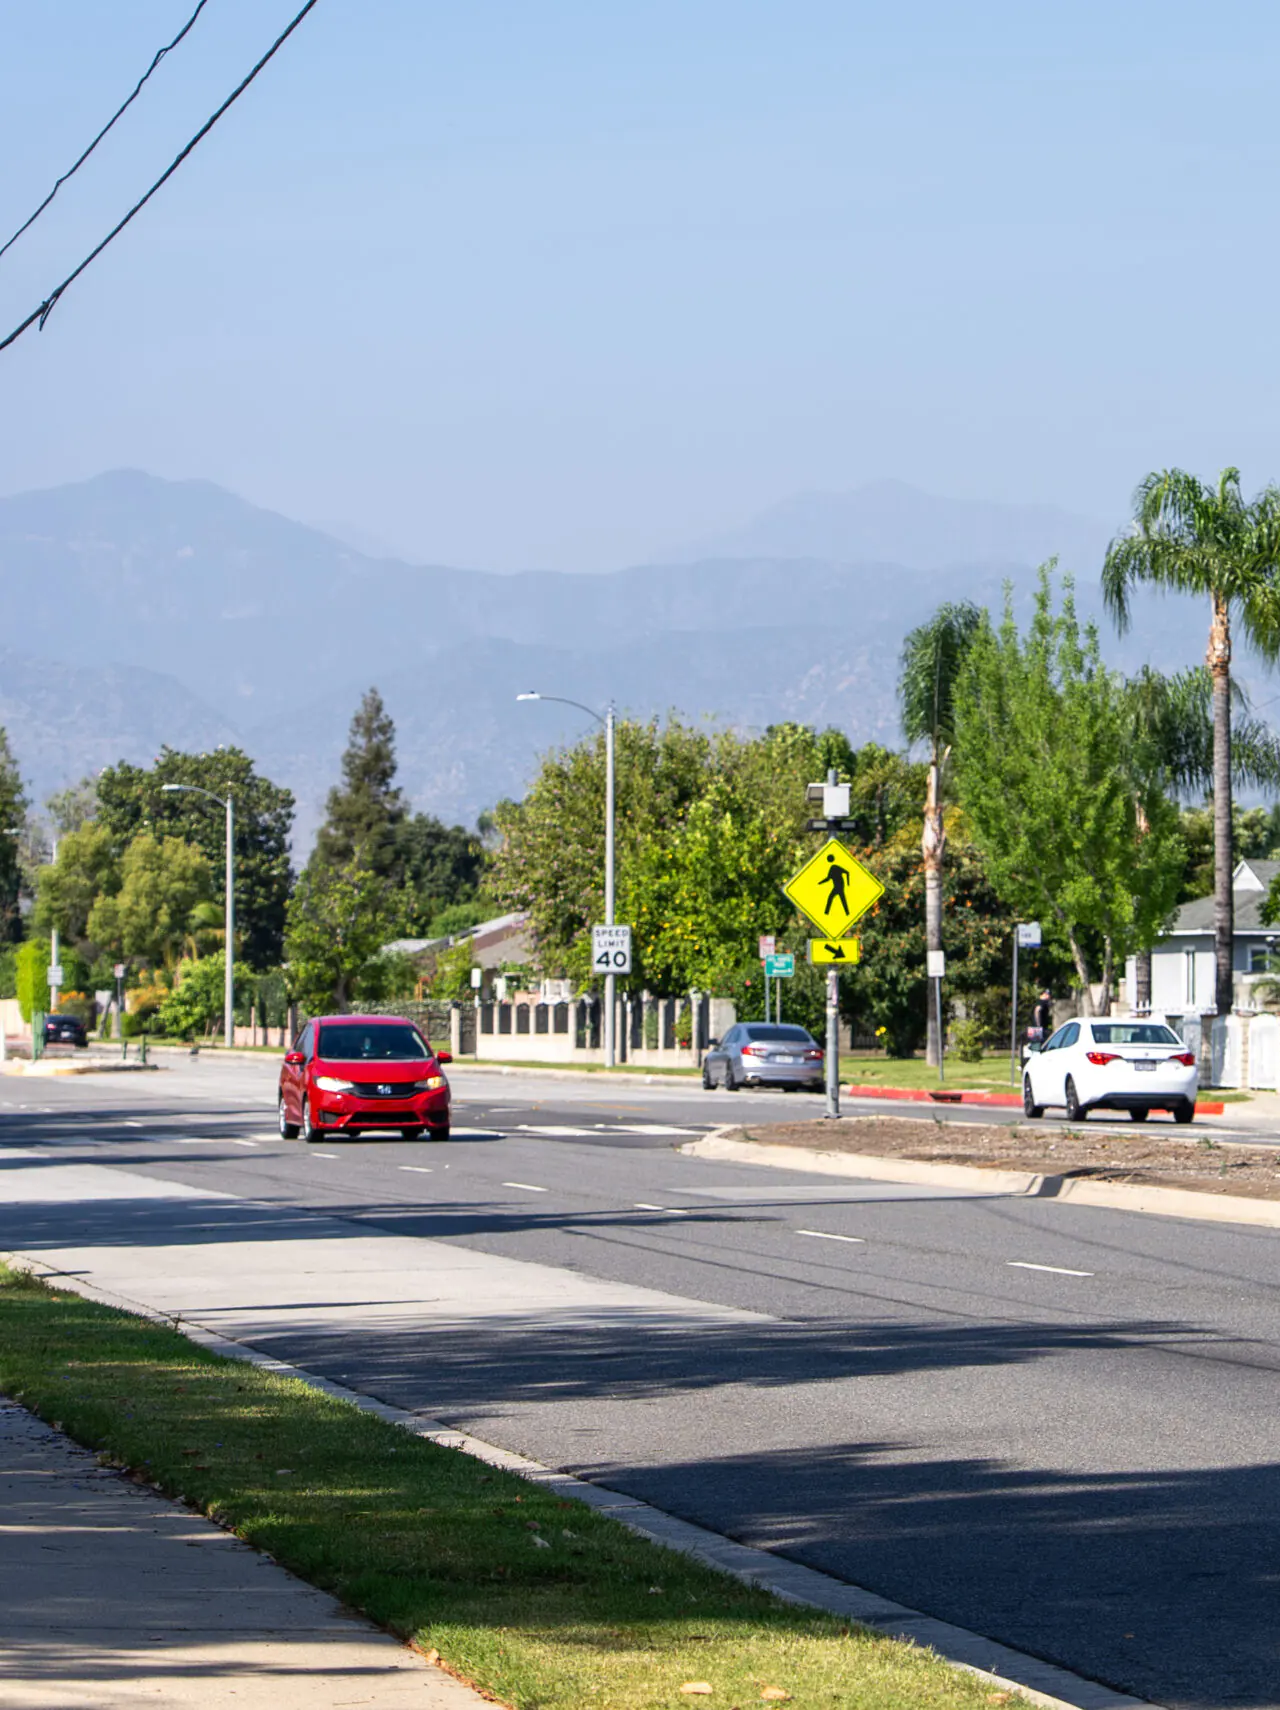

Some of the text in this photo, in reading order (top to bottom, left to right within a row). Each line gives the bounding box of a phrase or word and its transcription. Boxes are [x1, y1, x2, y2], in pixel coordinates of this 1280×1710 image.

[595, 929, 629, 937] SPEED
[598, 940, 625, 948] LIMIT
[596, 951, 627, 967] 40
